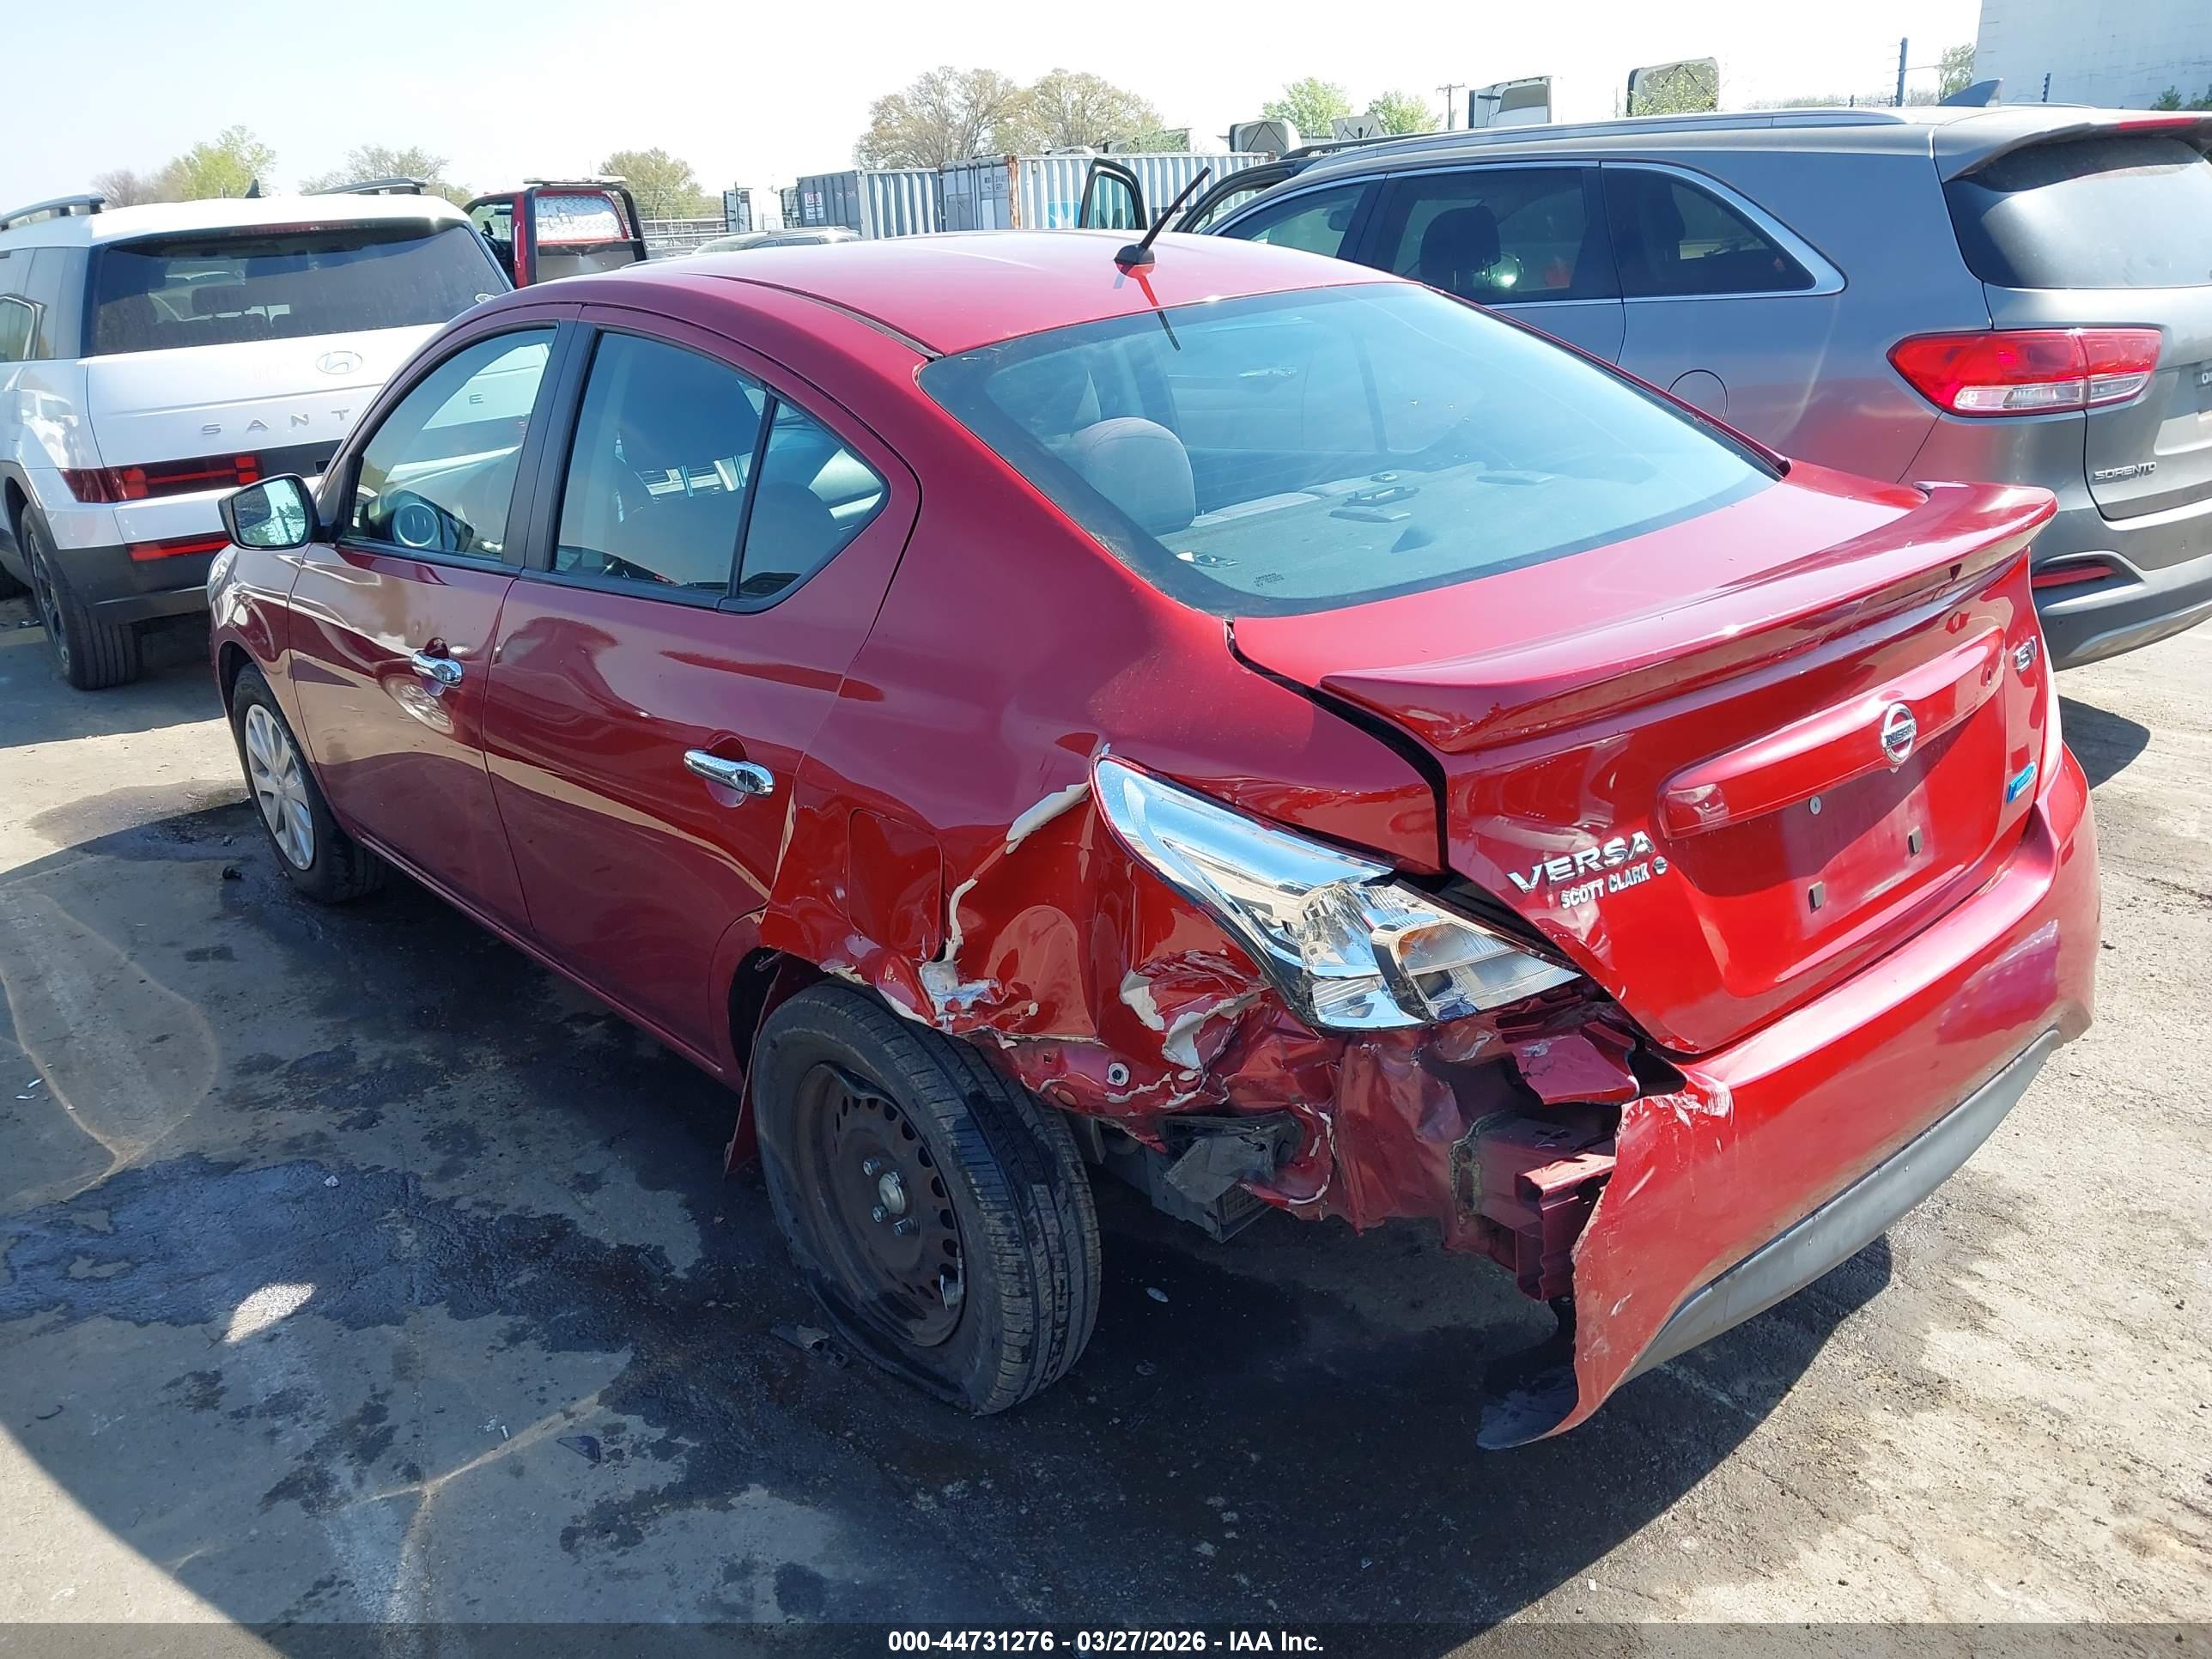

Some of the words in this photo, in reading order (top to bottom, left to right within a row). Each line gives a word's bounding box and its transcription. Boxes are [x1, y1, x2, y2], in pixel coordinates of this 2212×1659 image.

[201, 408, 351, 435] SANT
[468, 392, 484, 405] E
[2094, 461, 2157, 481] SORENTO
[2014, 635, 2037, 673] SV
[1506, 830, 1656, 894] VERSA
[1559, 879, 1606, 909] SCOTT
[1607, 862, 1651, 893] CLARK
